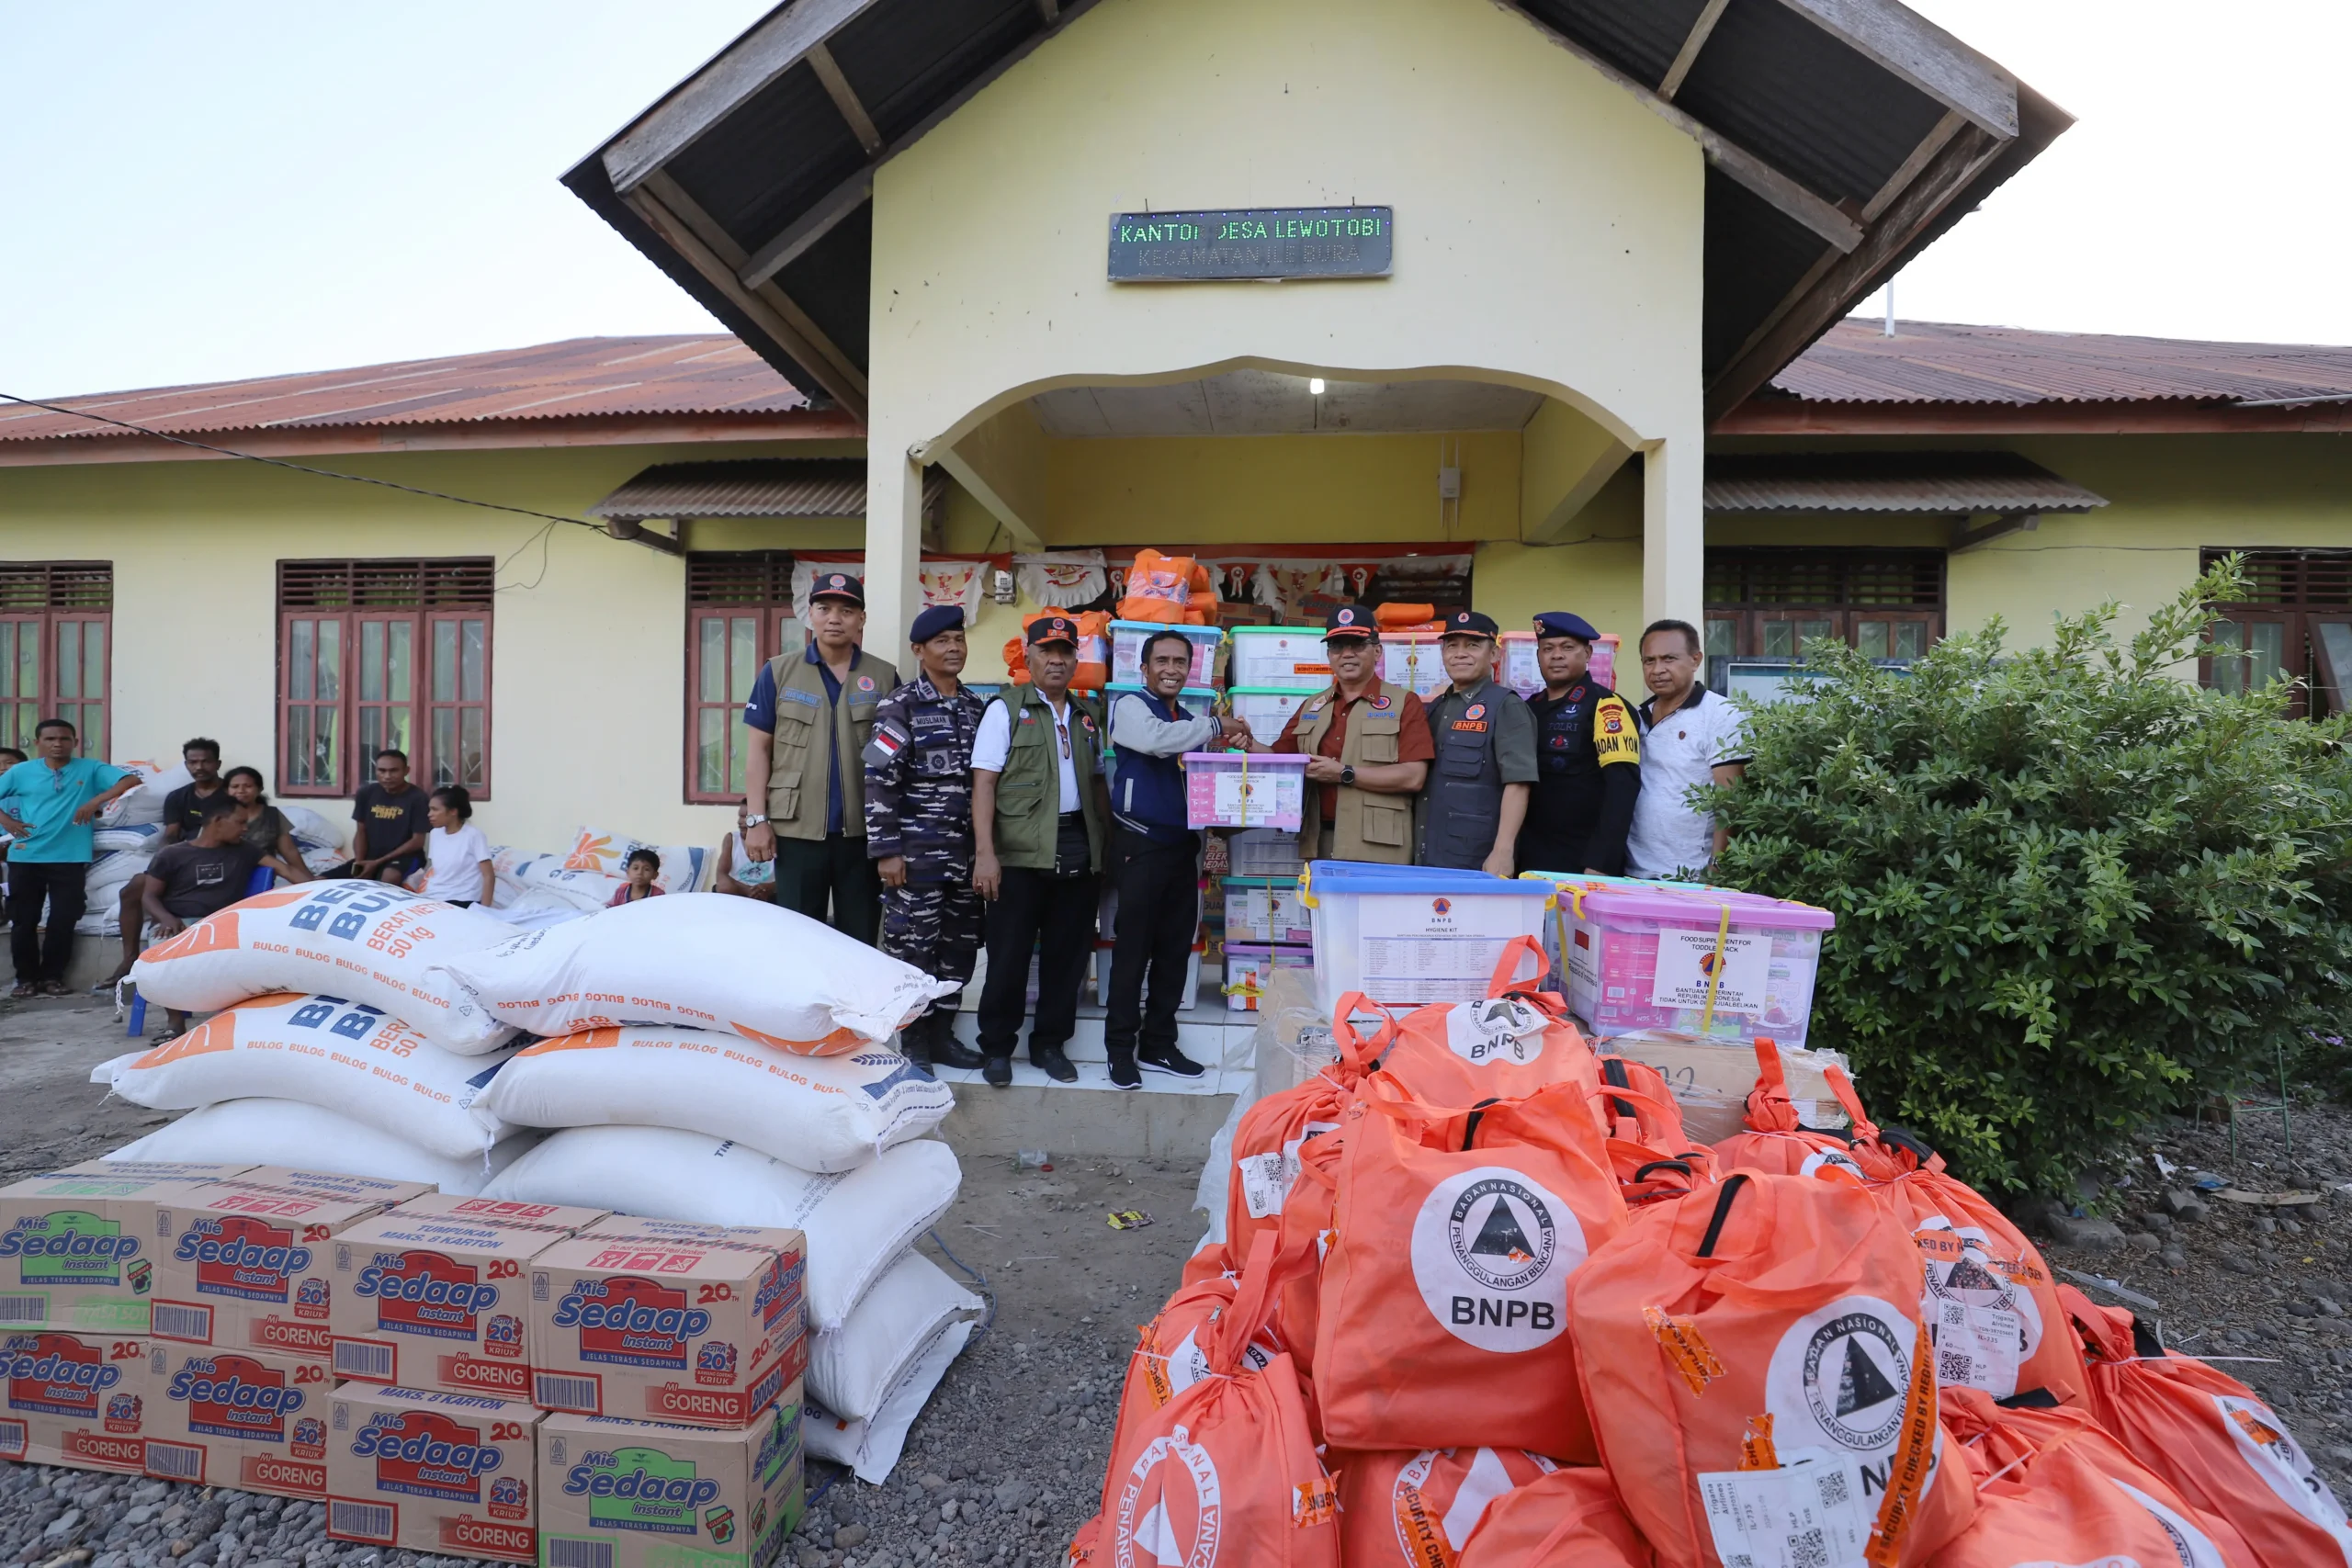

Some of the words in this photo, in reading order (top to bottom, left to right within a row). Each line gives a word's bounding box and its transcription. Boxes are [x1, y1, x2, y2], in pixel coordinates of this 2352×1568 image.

[1275, 217, 1381, 239] LEWOTOBI
[1138, 246, 1261, 266] KECAMATAN
[1303, 243, 1360, 262] BURA
[916, 716, 947, 726] MUSLIMAN
[1454, 722, 1484, 731] BNPB
[1547, 722, 1578, 732] POLRI
[366, 910, 413, 951] BERAT
[387, 939, 413, 959] 50
[403, 926, 435, 942] kg
[253, 941, 289, 953] BULOG
[295, 947, 331, 964] BULOG
[335, 957, 368, 976] BULOG
[373, 970, 406, 992] BULOG
[412, 987, 450, 1010] BULOG
[1696, 980, 1724, 988] BNB
[391, 1035, 418, 1059] 50
[1470, 1032, 1524, 1060] BNPB
[632, 1039, 673, 1049] BULOG
[678, 1043, 718, 1055] BULOG
[723, 1050, 763, 1068] BULOG
[768, 1065, 808, 1087] BULOG
[247, 1041, 283, 1050] BULOG
[288, 1043, 325, 1057] BULOG
[331, 1052, 368, 1070] BULOG
[372, 1066, 409, 1087] BULOG
[413, 1082, 451, 1104] BULOG
[1455, 1183, 1487, 1219] BADAN
[1490, 1182, 1549, 1224] NASIONAL
[17, 1218, 49, 1230] Mie
[192, 1220, 222, 1235] Mie
[417, 1225, 499, 1238] TUMPUKAN
[0, 1230, 139, 1262] Sedaap
[379, 1231, 423, 1242] MAKS.
[439, 1237, 504, 1249] KARTON
[175, 1233, 311, 1277] Sedaap
[373, 1254, 405, 1269] Mie
[1452, 1226, 1529, 1288] PENANGGULANGAN
[1528, 1230, 1552, 1278] BENCANA
[63, 1259, 108, 1269] Instant
[233, 1270, 277, 1285] Instant
[222, 1288, 245, 1297] TERASA
[247, 1292, 283, 1302] SEDAPNYA
[355, 1268, 498, 1314] Sedaap
[573, 1281, 608, 1297] Mie
[266, 1314, 278, 1324] MI
[298, 1309, 324, 1318] KRIUK
[418, 1306, 464, 1322] Instant
[553, 1297, 711, 1342] Sedaap
[1452, 1295, 1555, 1330] BNPB
[1992, 1314, 2015, 1323] Trigana
[264, 1325, 331, 1347] GORENG
[383, 1322, 403, 1331] JELAS
[405, 1325, 432, 1335] TERASA
[434, 1328, 471, 1339] SEDAPNYA
[1837, 1316, 1896, 1352] NASIONAL
[6, 1337, 38, 1350] Mie
[623, 1335, 673, 1351] Instant
[456, 1352, 469, 1361] MI
[489, 1347, 516, 1357] KRIUK
[586, 1352, 608, 1362] JELAS
[610, 1355, 639, 1365] TERASA
[641, 1358, 682, 1369] SEDAPNYA
[0, 1350, 119, 1392] Sedaap
[186, 1359, 216, 1373] Mie
[453, 1363, 524, 1385] GORENG
[665, 1382, 680, 1392] MI
[700, 1375, 729, 1385] KRIUK
[46, 1387, 87, 1401] Instant
[167, 1371, 304, 1416] Sedaap
[378, 1387, 424, 1401] MAKS.
[427, 1393, 438, 1402] 8
[440, 1393, 507, 1410] KARTON
[662, 1393, 739, 1415] GORENG
[227, 1410, 272, 1424] Instant
[370, 1414, 405, 1429] Mie
[78, 1428, 90, 1437] MI
[108, 1424, 134, 1432] KRIUK
[194, 1425, 213, 1433] JELAS
[216, 1427, 240, 1437] TERASA
[243, 1429, 279, 1441] SEDAPNYA
[77, 1438, 140, 1460] GORENG
[1903, 1418, 1927, 1483] CHECKED
[1917, 1398, 1929, 1420] BY
[260, 1452, 273, 1461] MI
[294, 1450, 320, 1459] KRIUK
[353, 1427, 502, 1475] Sedaap
[582, 1451, 618, 1468] Mie
[256, 1464, 323, 1486] GORENG
[418, 1467, 468, 1484] Instant
[383, 1483, 403, 1492] JELAS
[406, 1486, 433, 1496] TERASA
[435, 1490, 475, 1502] SEDAPNYA
[563, 1466, 720, 1510] Sedaap
[1707, 1483, 1720, 1516] Trigana
[1717, 1483, 1729, 1515] Airlines
[492, 1509, 521, 1519] KRIUK
[632, 1502, 683, 1517] Instant
[458, 1514, 472, 1523] MI
[456, 1524, 529, 1549] GORENG
